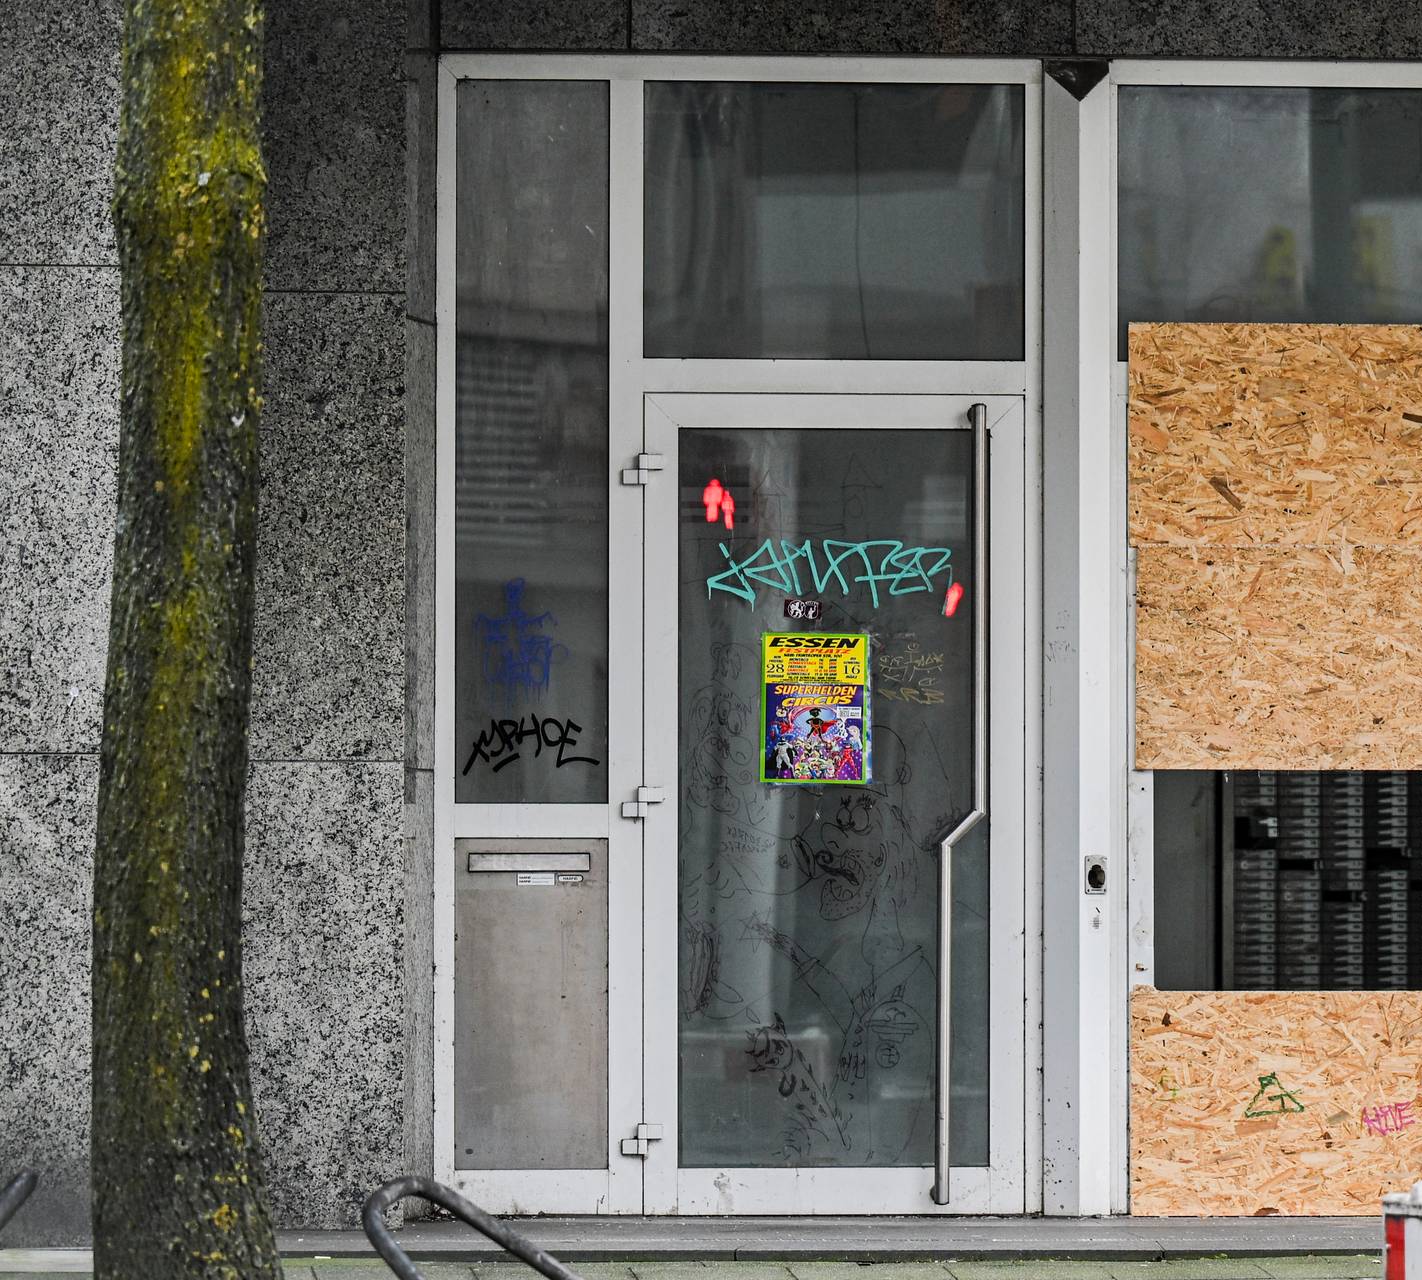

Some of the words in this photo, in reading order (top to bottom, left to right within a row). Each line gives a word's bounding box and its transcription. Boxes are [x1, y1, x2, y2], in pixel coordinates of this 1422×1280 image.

[769, 637, 860, 649] ESSEN
[766, 663, 784, 673] 28
[844, 665, 860, 674] 16
[774, 685, 857, 696] SUPERHELDEN
[782, 695, 853, 707] CIRCUS
